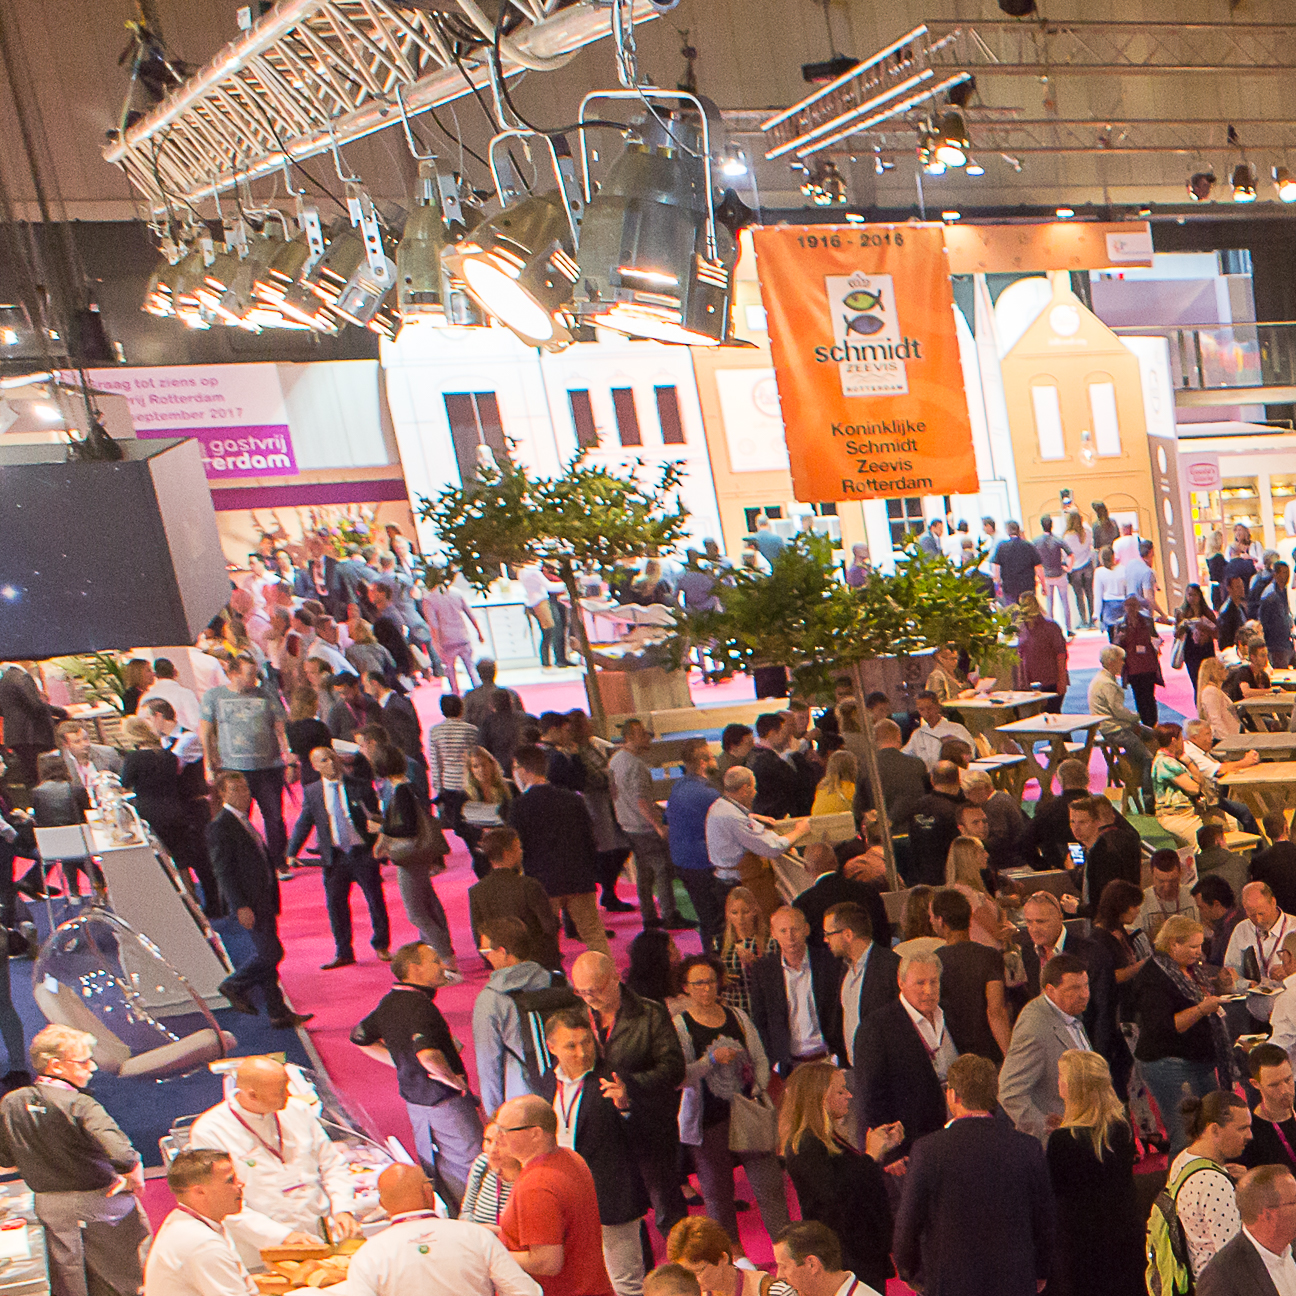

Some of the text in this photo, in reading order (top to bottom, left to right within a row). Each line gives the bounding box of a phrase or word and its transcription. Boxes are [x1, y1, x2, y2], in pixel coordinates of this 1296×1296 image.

[797, 233, 840, 249] 1916
[860, 232, 905, 248] 2016
[815, 337, 922, 363] schmidt
[845, 361, 898, 373] ZEEVIS
[134, 377, 155, 389] tot
[159, 376, 196, 388] ziens
[201, 376, 219, 388] op
[149, 392, 226, 406] Rotterdam
[210, 407, 243, 420] 2017
[830, 419, 927, 437] Koninklijke
[208, 433, 288, 456] gastvrij
[845, 438, 918, 455] Schmidt
[856, 457, 913, 473] Zeevis
[841, 475, 933, 493] Rotterdam
